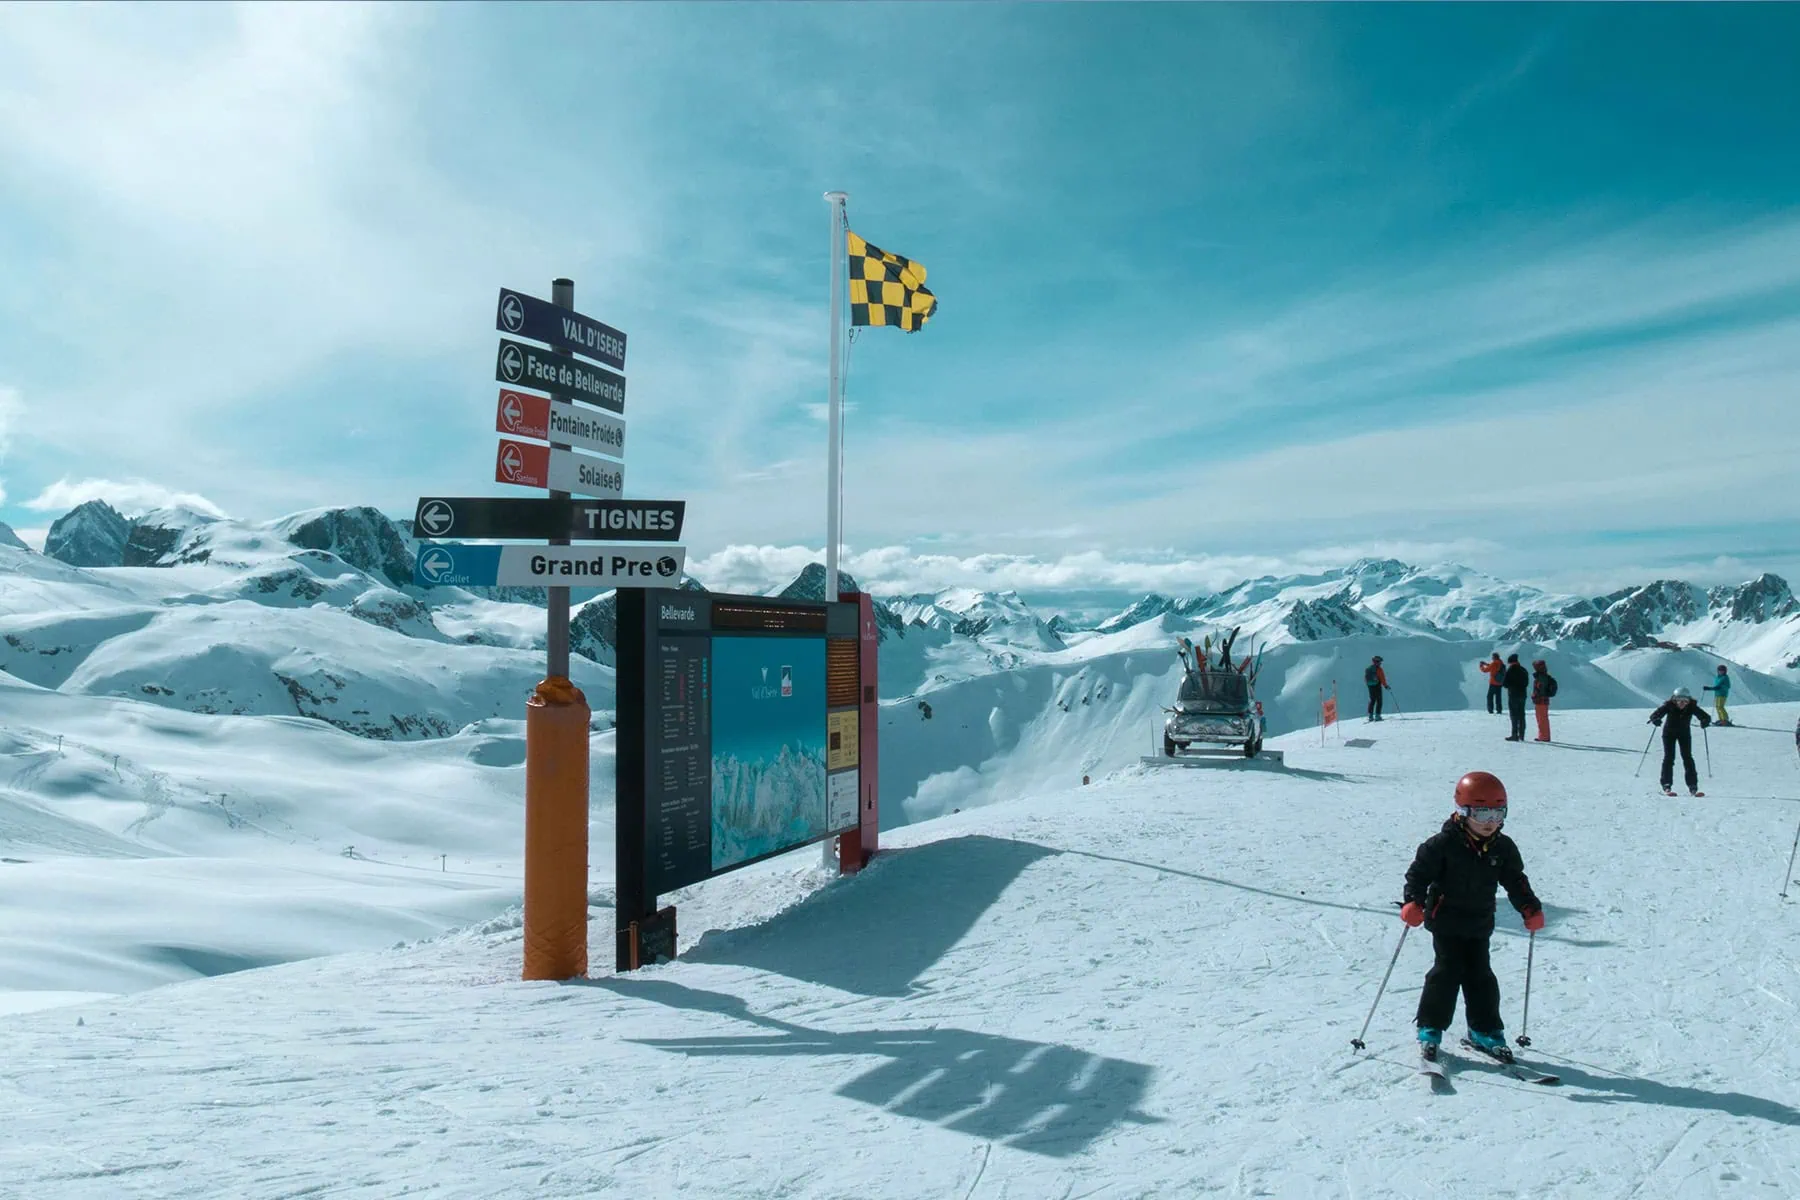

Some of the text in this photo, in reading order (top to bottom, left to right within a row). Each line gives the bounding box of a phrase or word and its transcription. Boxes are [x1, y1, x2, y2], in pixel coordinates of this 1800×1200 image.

[562, 317, 623, 360] VAL D'ISERE
[527, 354, 622, 403] Face de Bellevarde
[550, 410, 615, 445] Fontaine Froide
[578, 463, 614, 489] Solaise
[584, 508, 676, 531] TIGNES
[530, 554, 654, 577] Grand Pre
[443, 573, 471, 584] Collet
[661, 604, 695, 621] Bellevarde
